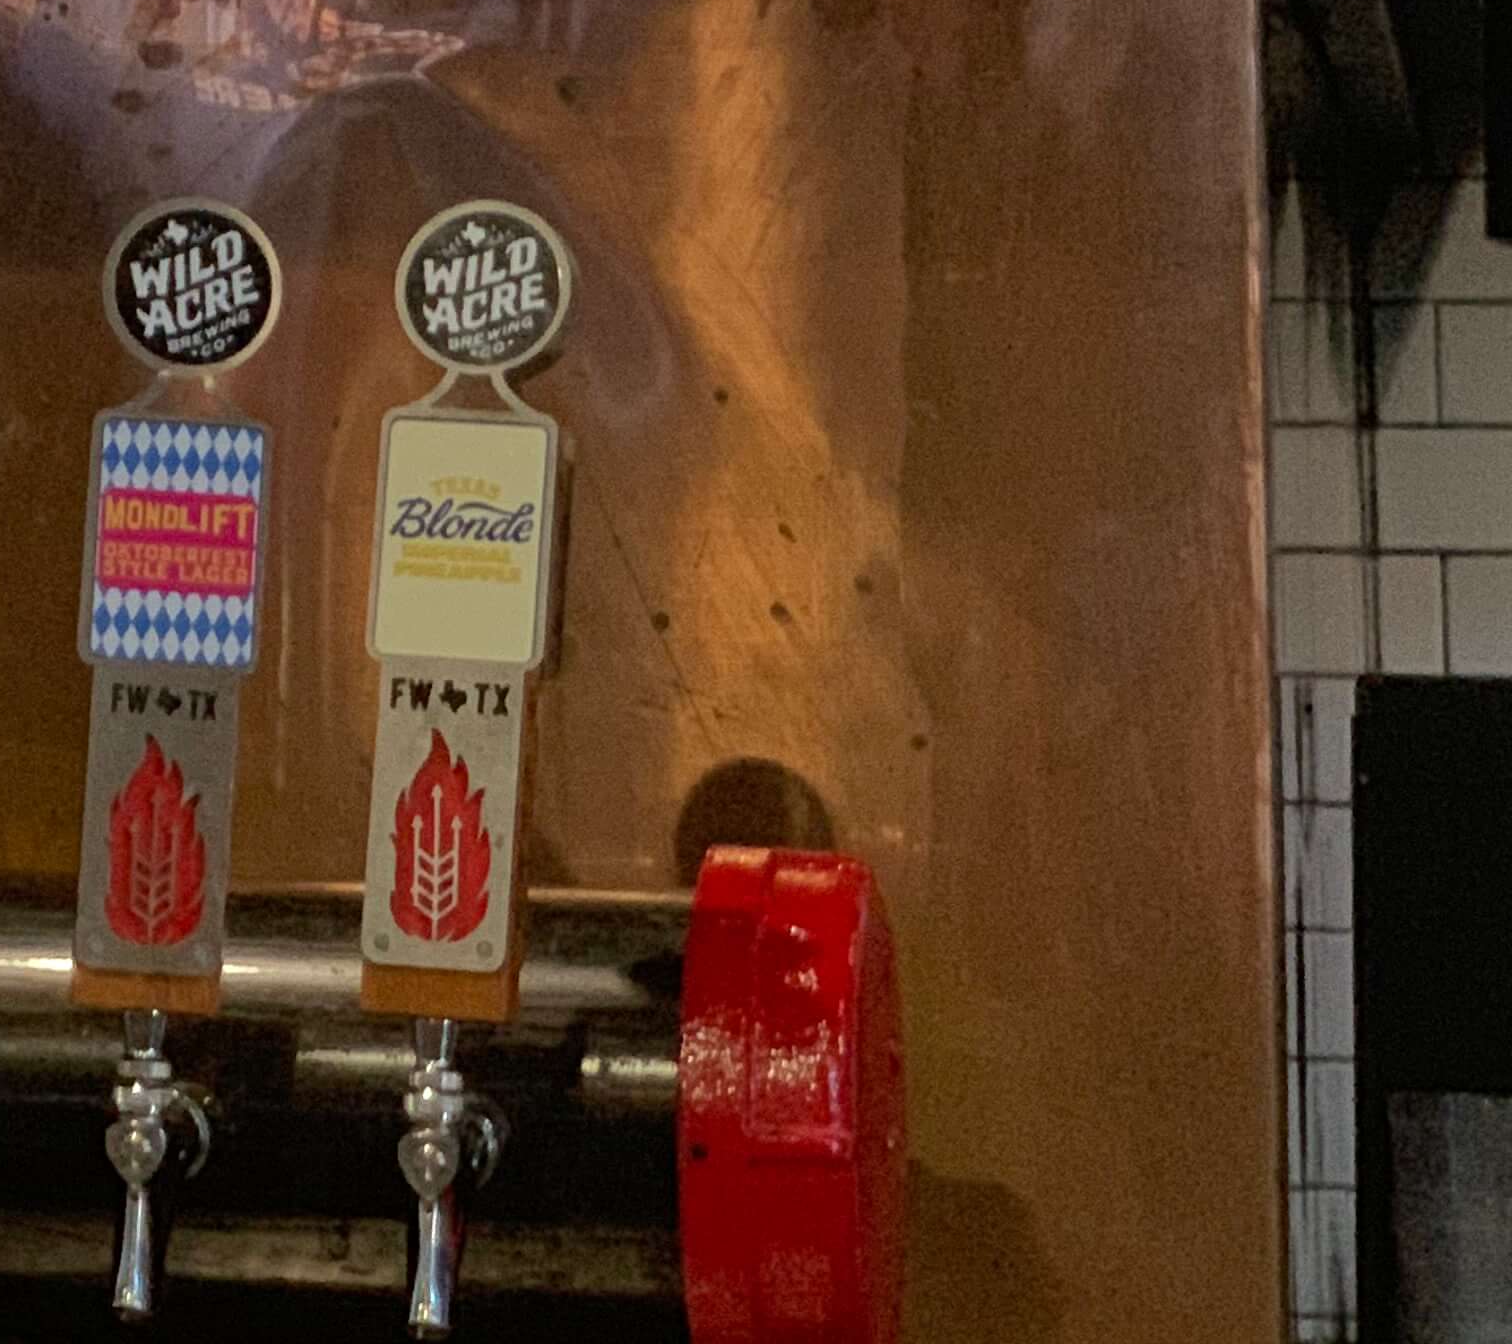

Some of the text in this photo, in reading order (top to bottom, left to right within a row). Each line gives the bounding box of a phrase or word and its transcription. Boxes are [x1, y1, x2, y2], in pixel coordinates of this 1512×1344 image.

[129, 231, 247, 300] WILD
[422, 233, 539, 299] WILD
[135, 266, 259, 339] ACRE
[422, 271, 547, 337] ACRE
[165, 309, 251, 356] BREWING
[447, 315, 535, 354] BREWING
[430, 476, 503, 502] TEXAS
[104, 494, 254, 542] MONDLIFT
[390, 496, 535, 544] Blonde
[102, 540, 248, 570] OKTOBERFEST
[102, 558, 249, 587] STYLE LAGER
[110, 681, 218, 721] FW TX
[390, 676, 511, 718] FW TX
